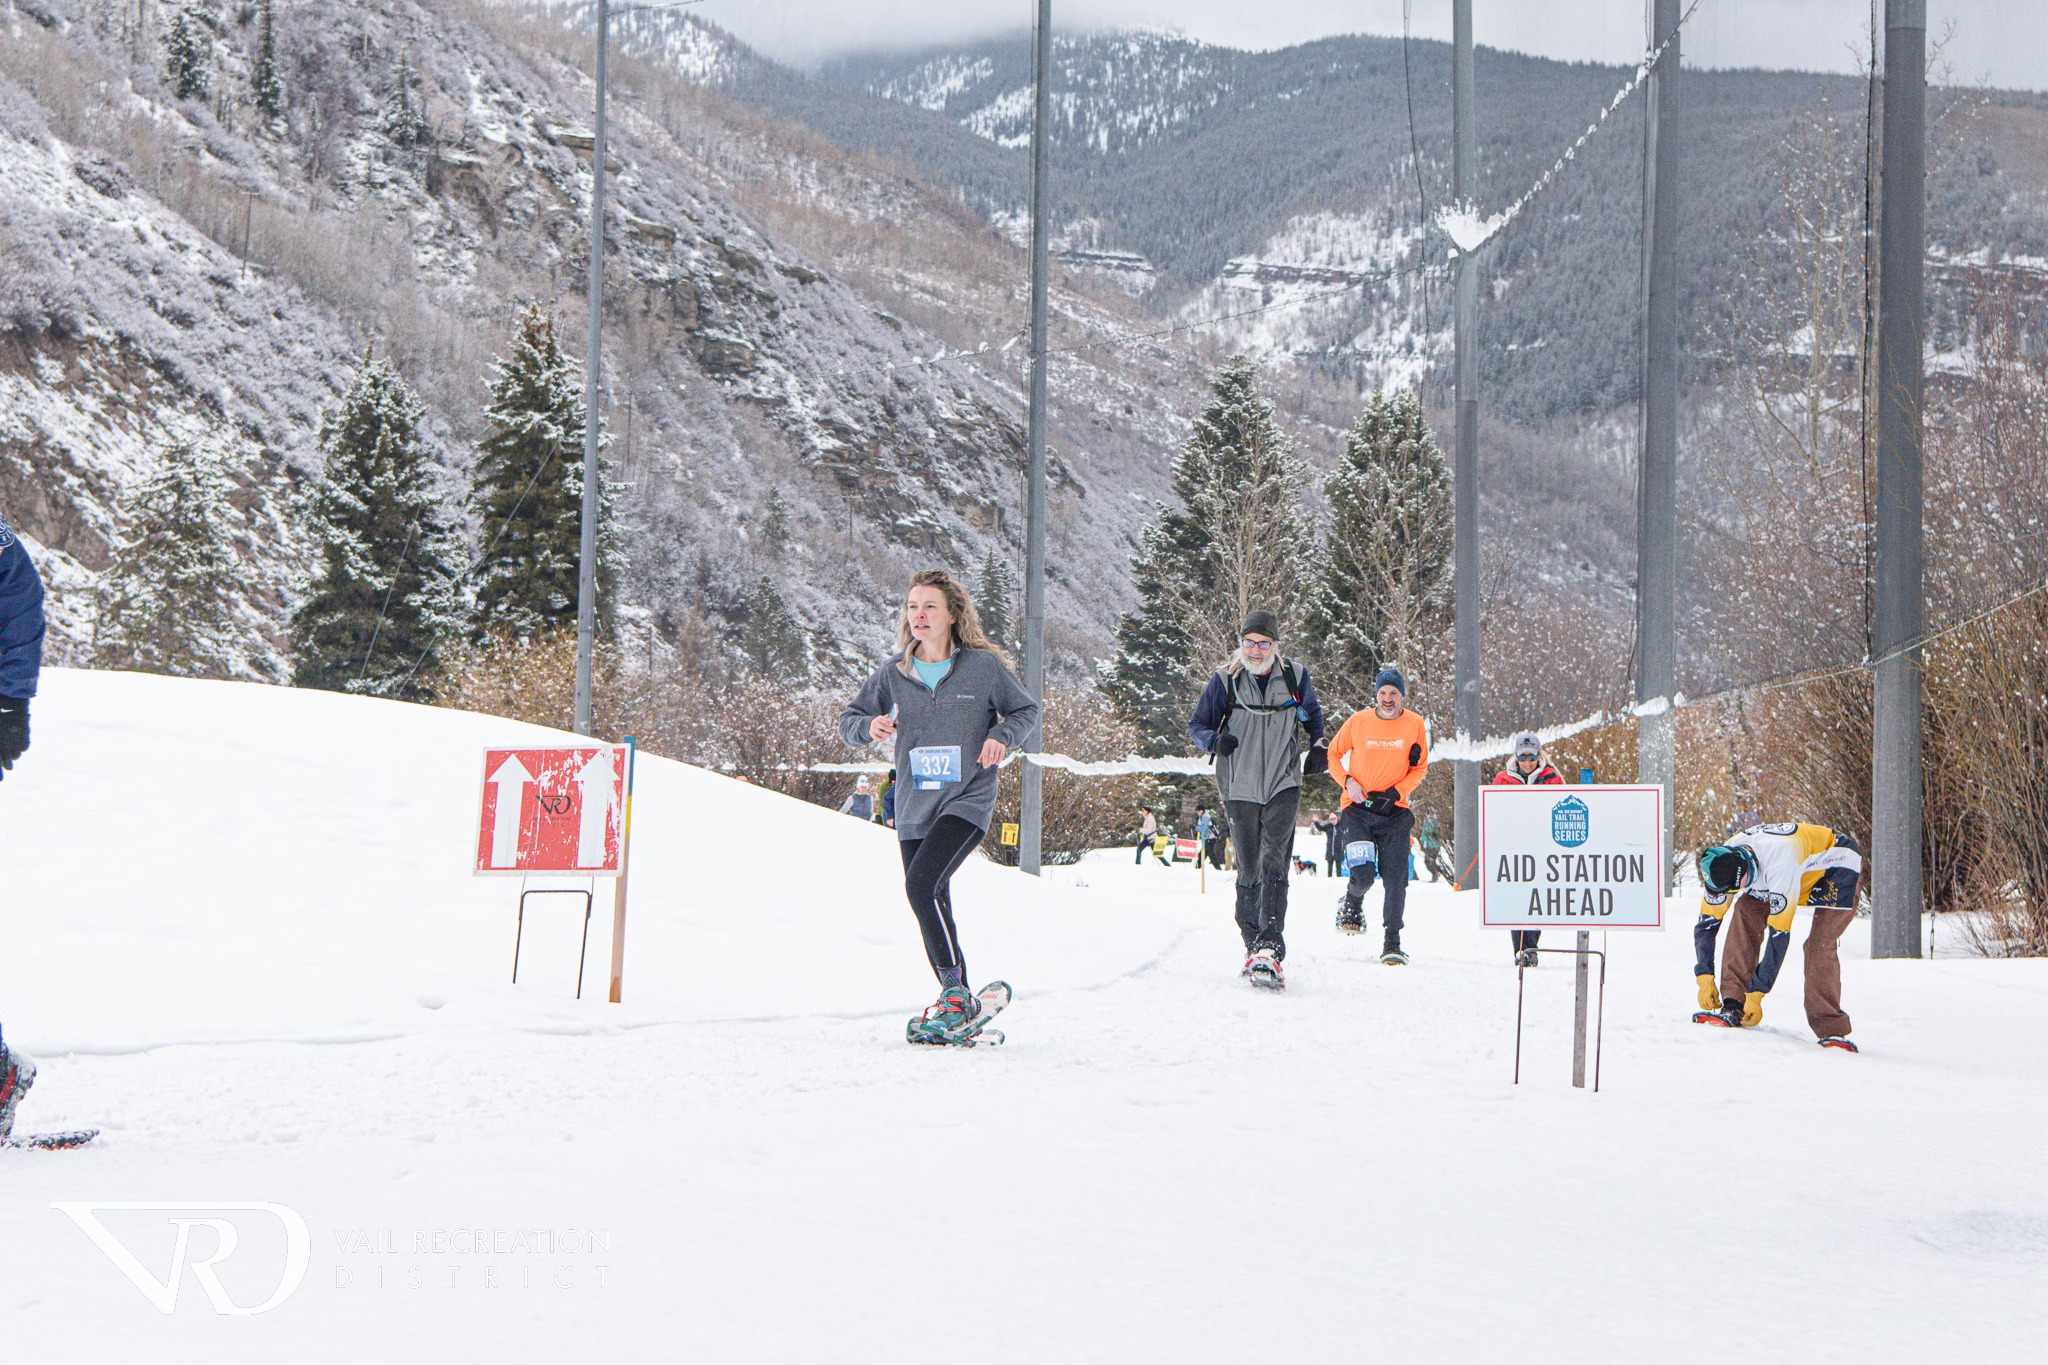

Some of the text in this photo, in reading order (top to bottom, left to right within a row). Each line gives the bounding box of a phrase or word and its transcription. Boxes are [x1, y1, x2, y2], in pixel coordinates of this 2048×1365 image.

[921, 755, 951, 776] 332
[1554, 821, 1586, 830] RUNNING
[1554, 830, 1586, 841] SERIES
[1351, 847, 1370, 858] 391
[1496, 854, 1644, 883] AID STATION
[1528, 888, 1613, 916] AHEAD
